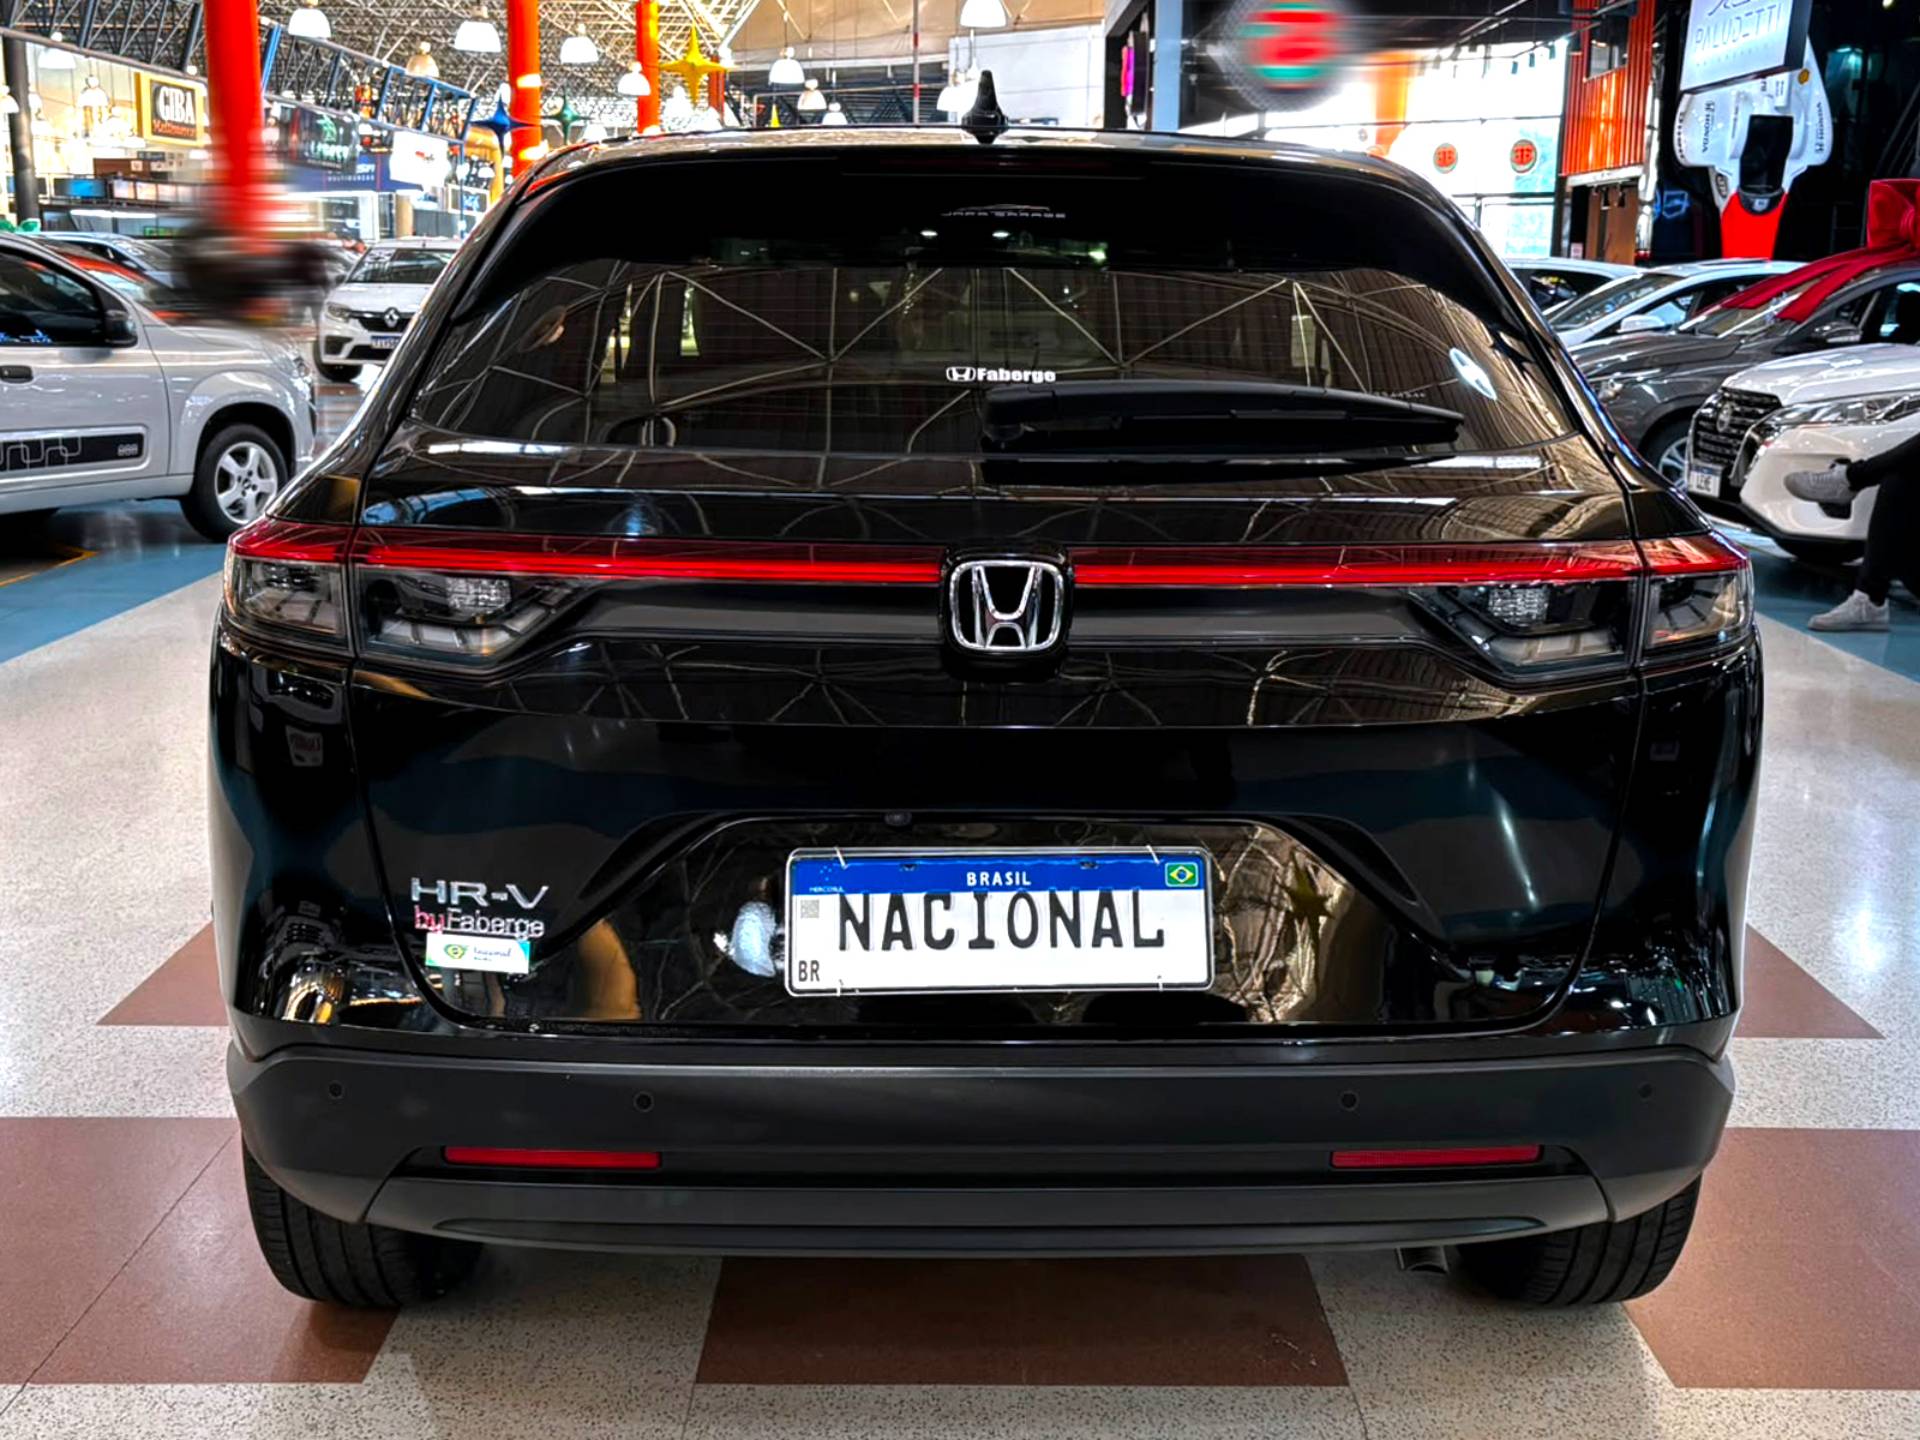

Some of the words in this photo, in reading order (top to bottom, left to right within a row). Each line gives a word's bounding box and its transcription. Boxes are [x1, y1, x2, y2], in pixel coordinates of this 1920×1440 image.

[157, 86, 195, 125] GIBA
[411, 877, 549, 909] HR-V
[966, 871, 1032, 887] BRASIL
[838, 888, 1165, 952] NACIONAL
[798, 960, 820, 982] BR
